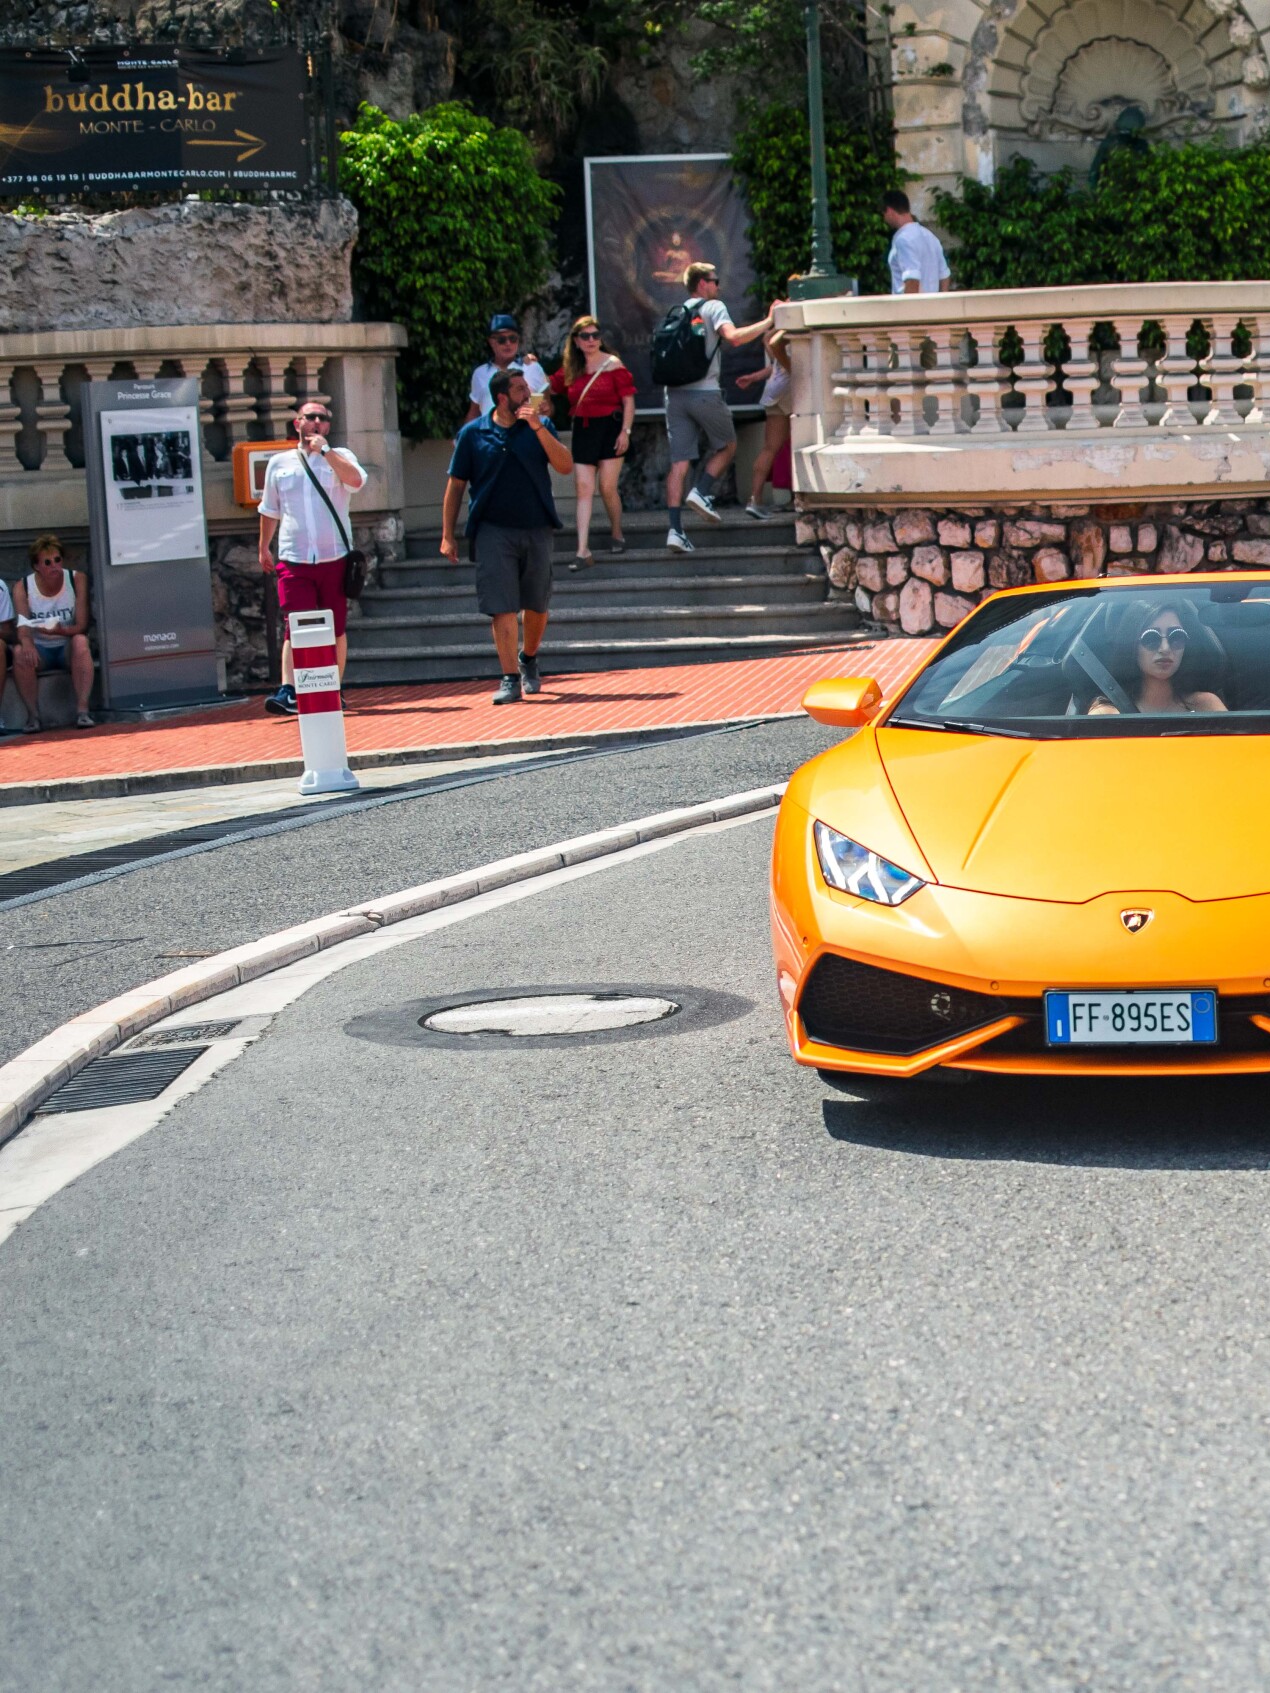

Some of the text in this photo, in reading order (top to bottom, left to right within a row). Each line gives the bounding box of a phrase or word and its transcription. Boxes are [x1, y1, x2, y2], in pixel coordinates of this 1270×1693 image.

[44, 81, 236, 113] buddha-bar
[79, 120, 144, 135] MONTE
[160, 118, 216, 133] CARLO
[26, 174, 38, 182] 98
[41, 174, 53, 182] 06
[69, 173, 79, 181] 19
[151, 390, 172, 399] Grace
[144, 632, 176, 642] monaco
[1072, 1003, 1190, 1032] FF 895ES
